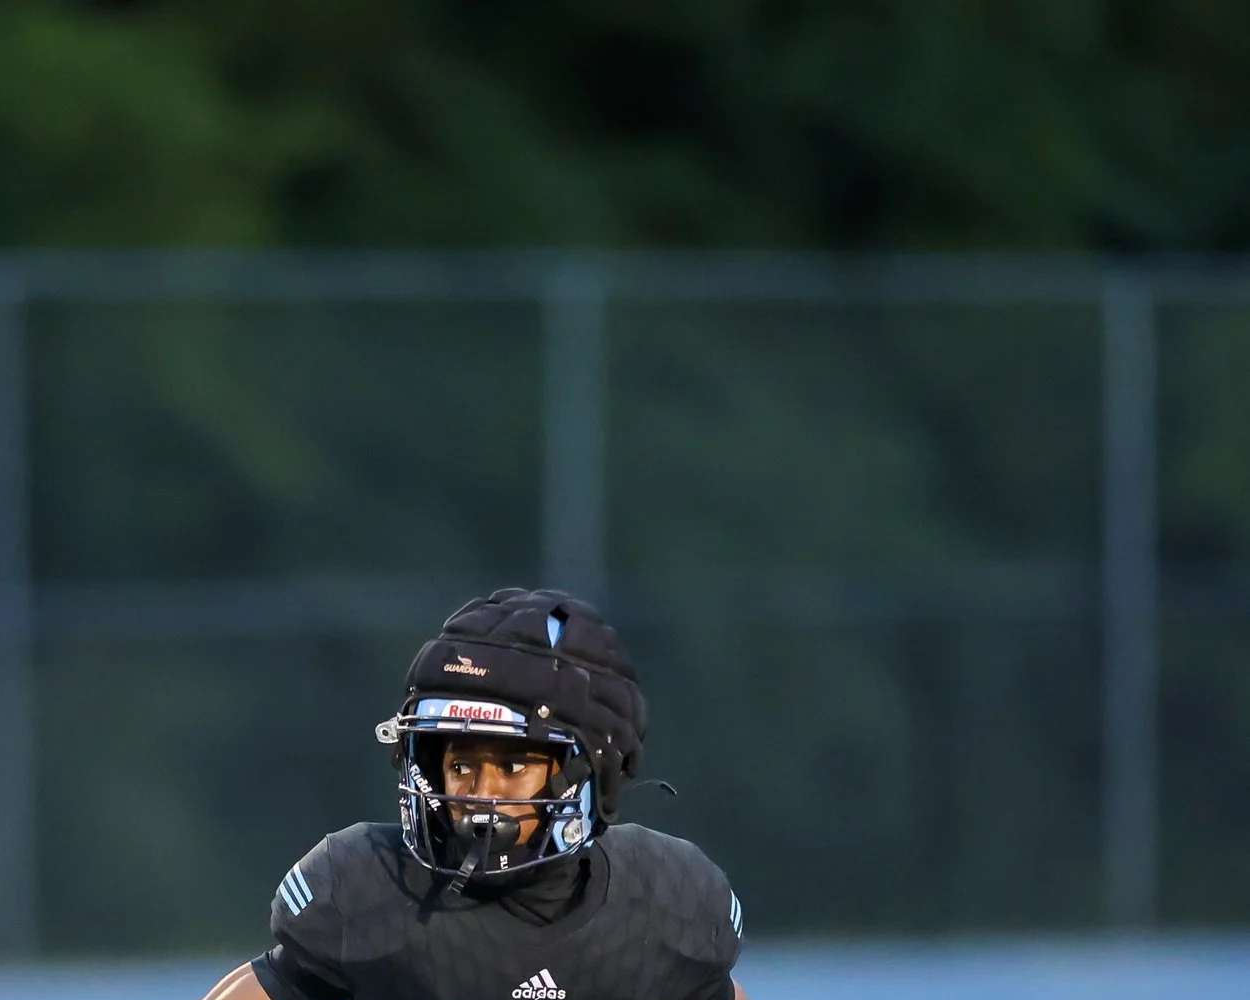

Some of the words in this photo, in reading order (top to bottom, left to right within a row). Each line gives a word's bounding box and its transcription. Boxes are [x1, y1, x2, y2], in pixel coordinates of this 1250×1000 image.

[444, 664, 487, 677] GUARDIAN
[449, 705, 503, 719] Riddell
[410, 764, 441, 809] Riddll
[511, 986, 567, 1000] adidas
